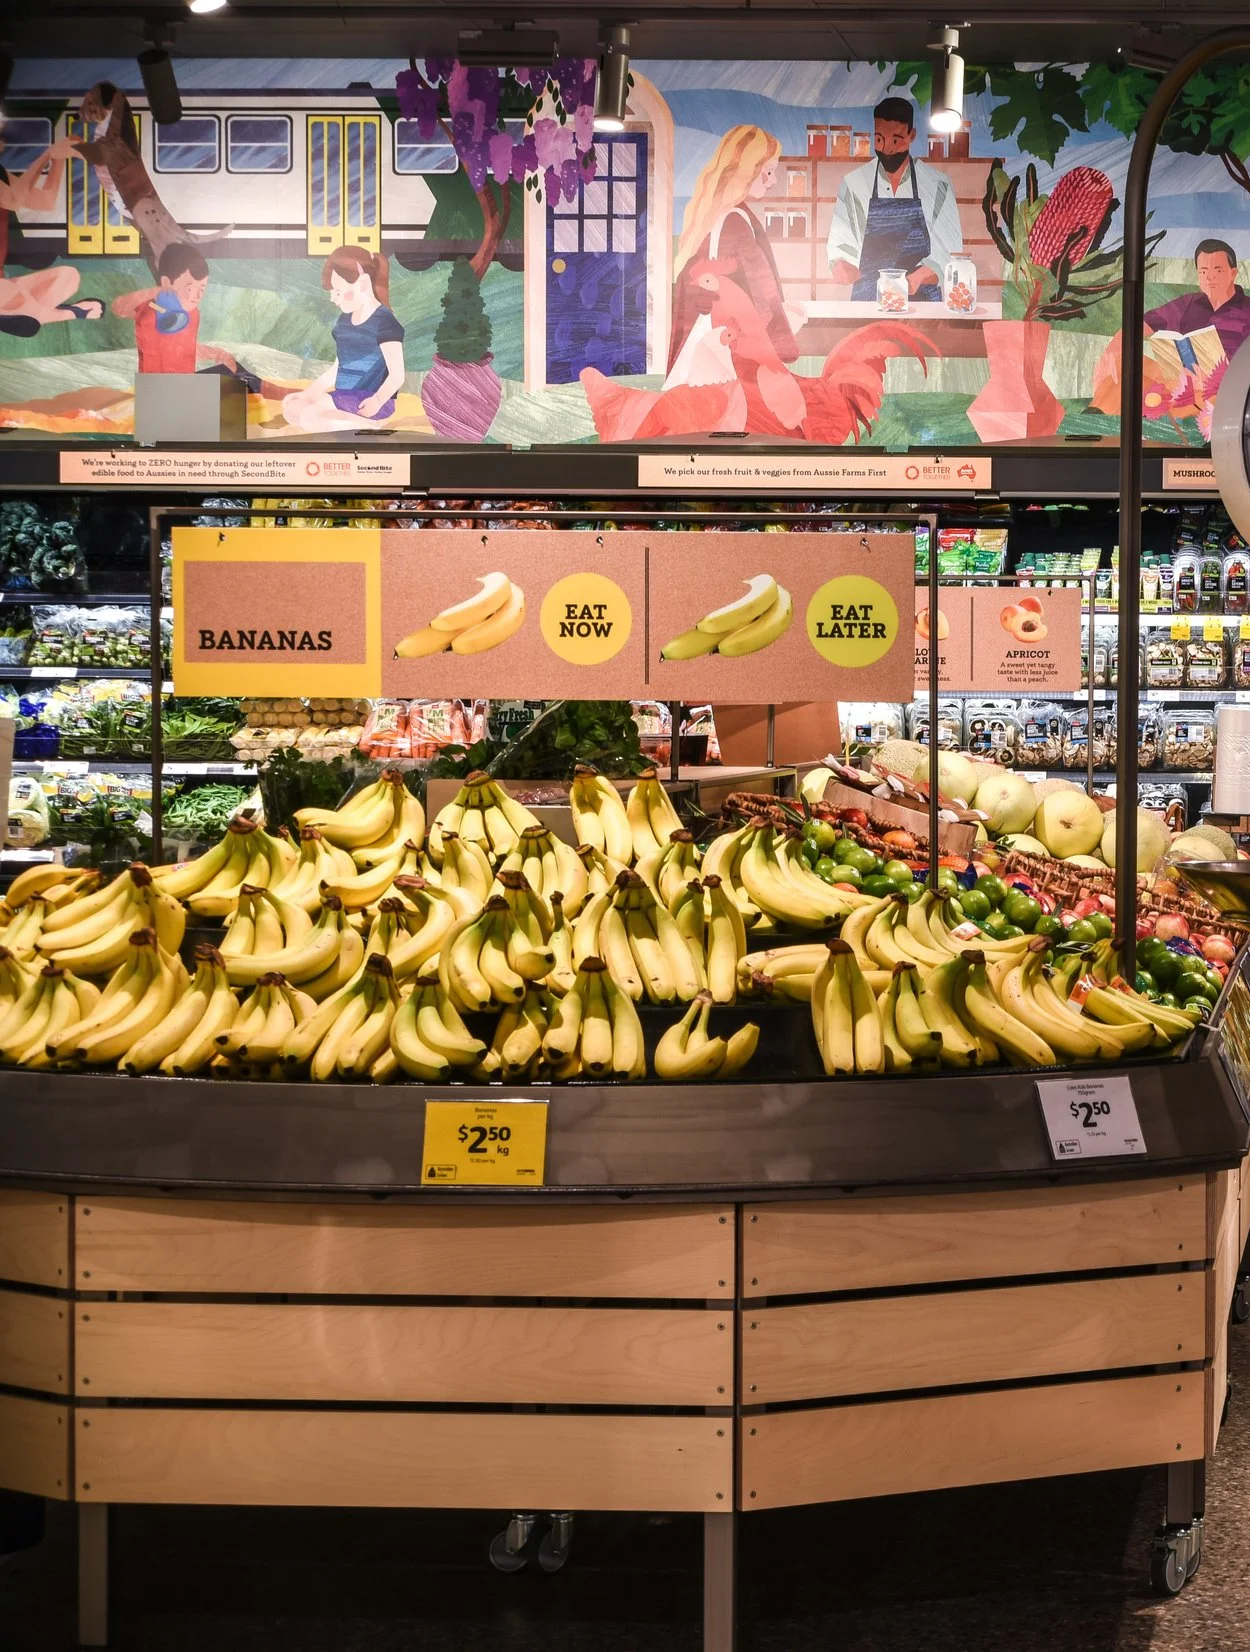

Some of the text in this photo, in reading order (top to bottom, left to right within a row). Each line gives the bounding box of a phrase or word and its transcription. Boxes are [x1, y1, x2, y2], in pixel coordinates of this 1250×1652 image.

[105, 459, 137, 468] working
[149, 459, 172, 467] ZERO
[174, 460, 201, 468] hunger
[202, 460, 212, 468] by
[214, 460, 248, 469] donating
[323, 462, 351, 470] BETTER
[208, 470, 239, 478] through
[241, 470, 286, 478] SecondBite
[664, 467, 677, 475] We
[678, 468, 695, 477] pick
[712, 468, 732, 476] fresh
[734, 468, 752, 476] fruit
[762, 469, 791, 478] veggies
[793, 468, 812, 476] from
[868, 469, 886, 477] First
[565, 604, 607, 620] EAT
[831, 605, 873, 621] EAT
[559, 621, 614, 637] NOW
[816, 623, 886, 639] LATER
[199, 629, 332, 651] BANANAS
[1006, 650, 1050, 658] APRICOT
[497, 1145, 510, 1156] kg
